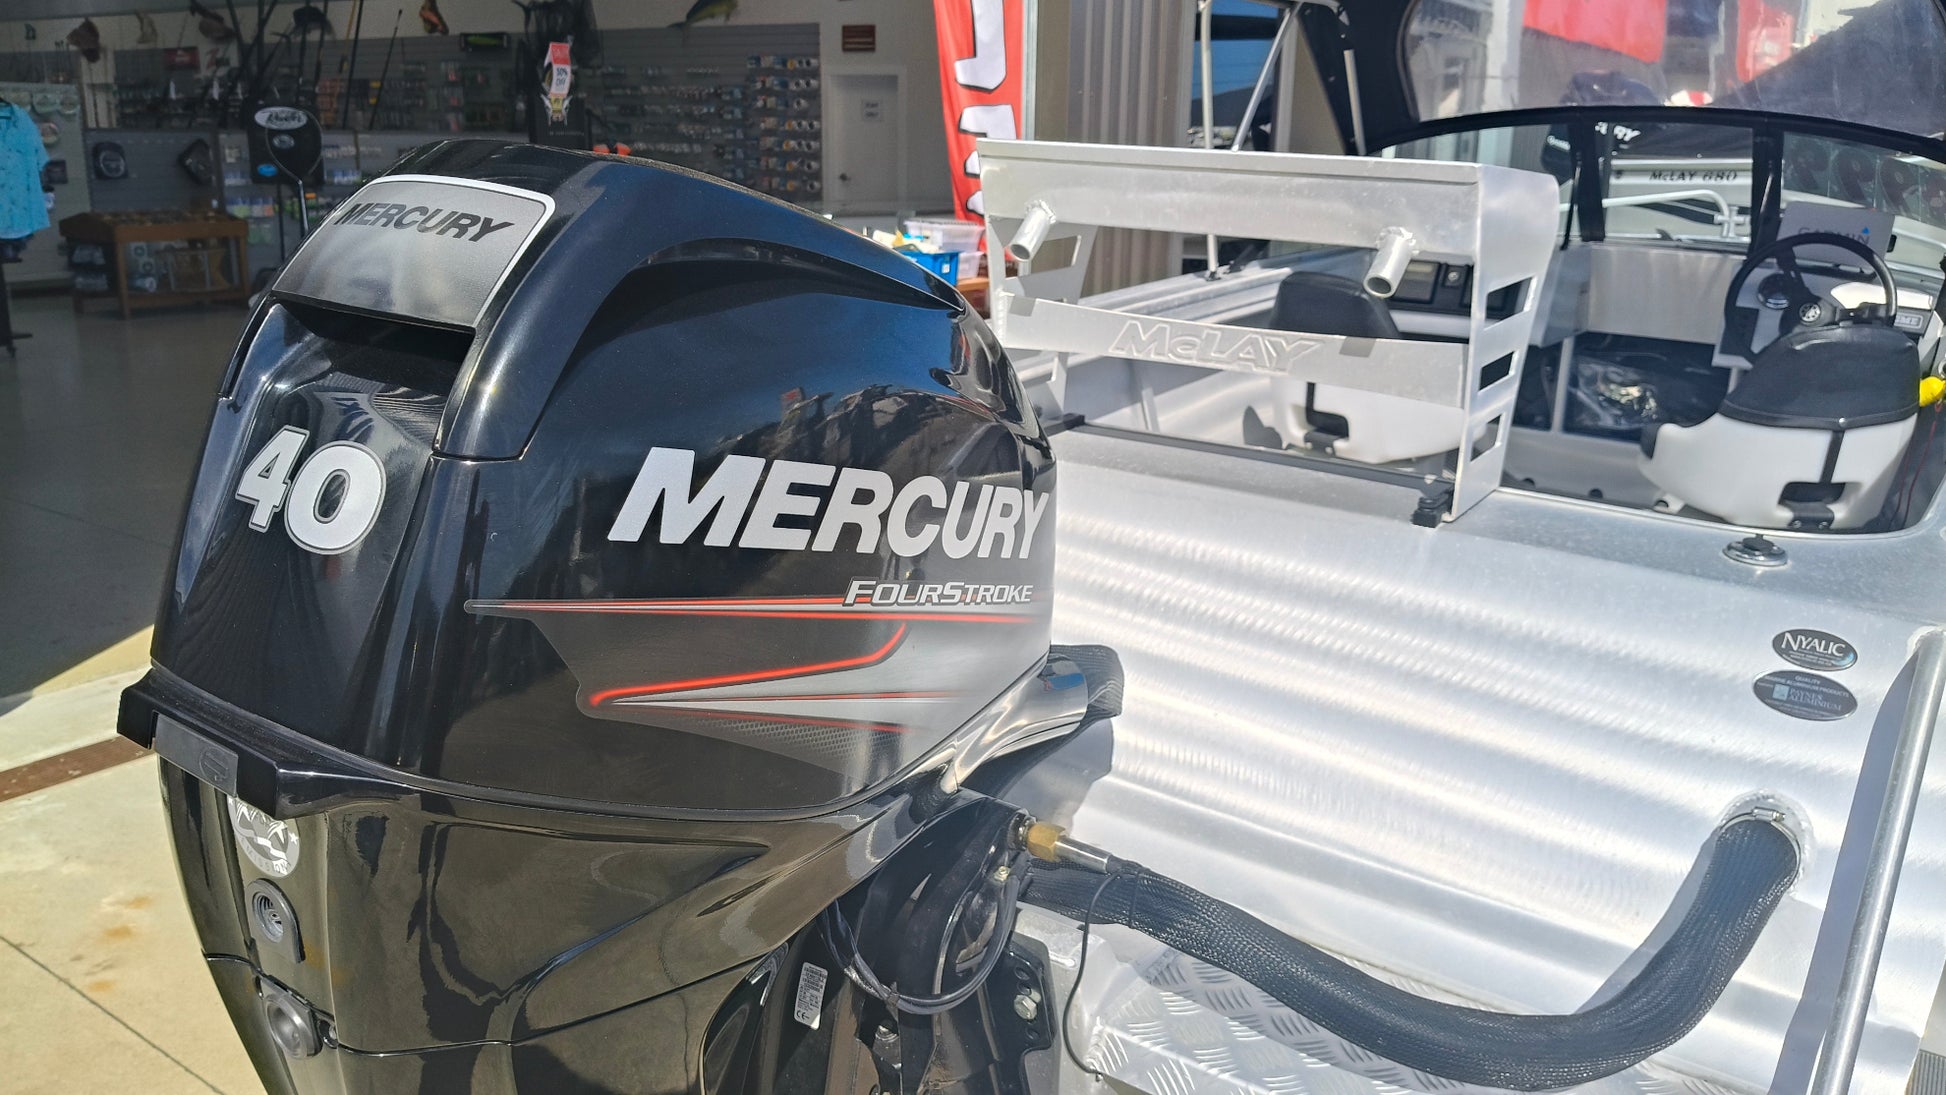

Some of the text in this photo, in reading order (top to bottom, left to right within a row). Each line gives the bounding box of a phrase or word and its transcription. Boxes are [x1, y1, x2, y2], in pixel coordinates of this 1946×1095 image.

[334, 203, 514, 242] MERCURY
[1108, 320, 1321, 375] McLAY
[235, 425, 387, 556] 40
[607, 446, 1050, 559] MERCURY
